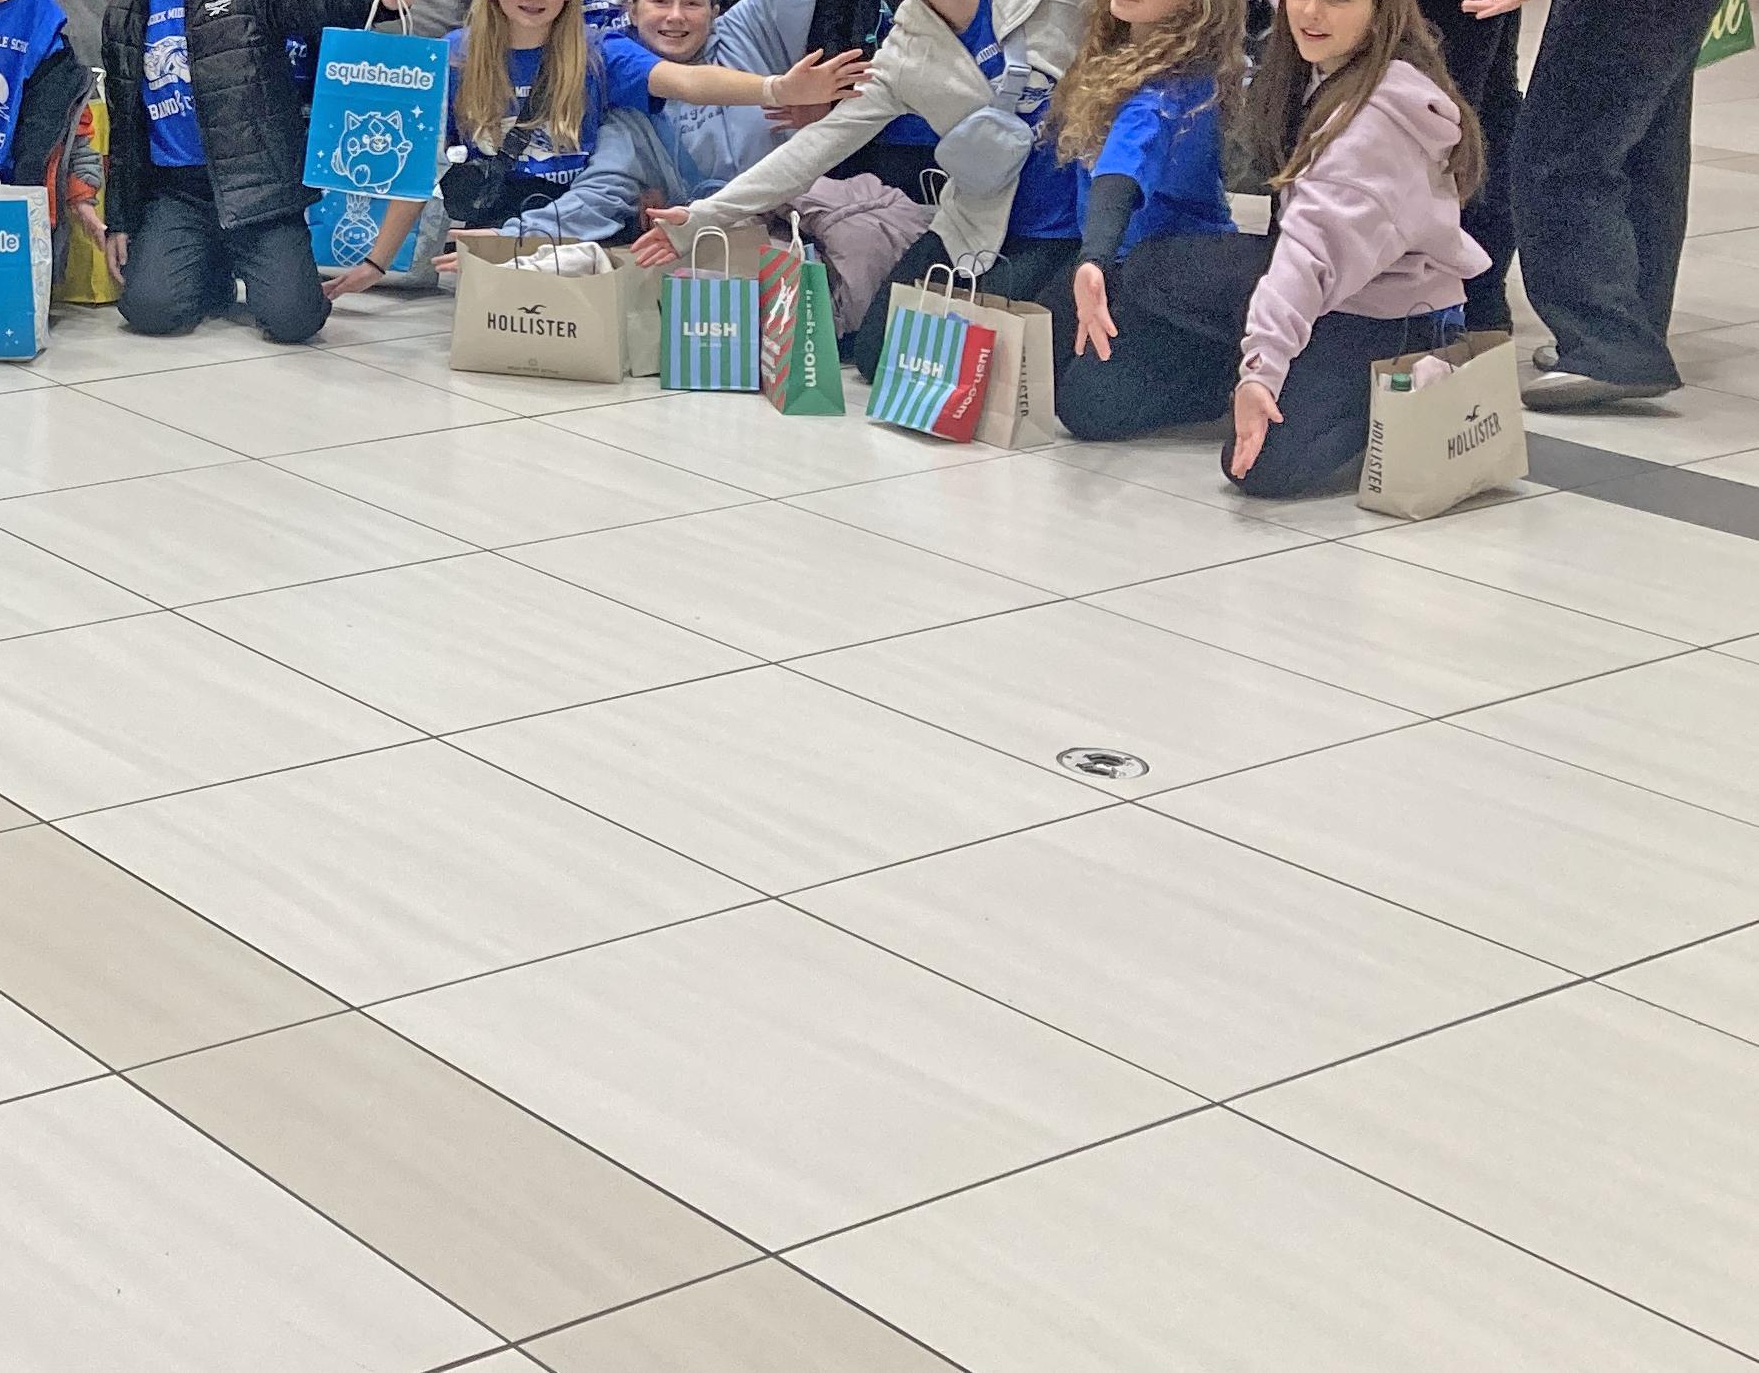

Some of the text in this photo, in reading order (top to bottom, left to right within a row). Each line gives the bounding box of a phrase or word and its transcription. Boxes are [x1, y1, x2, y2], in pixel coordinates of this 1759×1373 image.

[326, 62, 433, 89] squishable
[147, 97, 181, 121] BAND
[487, 311, 577, 339] HOLLISTER
[682, 321, 738, 337] LUSH
[898, 353, 945, 379] LUSH
[951, 348, 992, 420] lush.com
[1447, 411, 1502, 460] HOLLISTER
[1368, 419, 1384, 494] HOLLISTER
